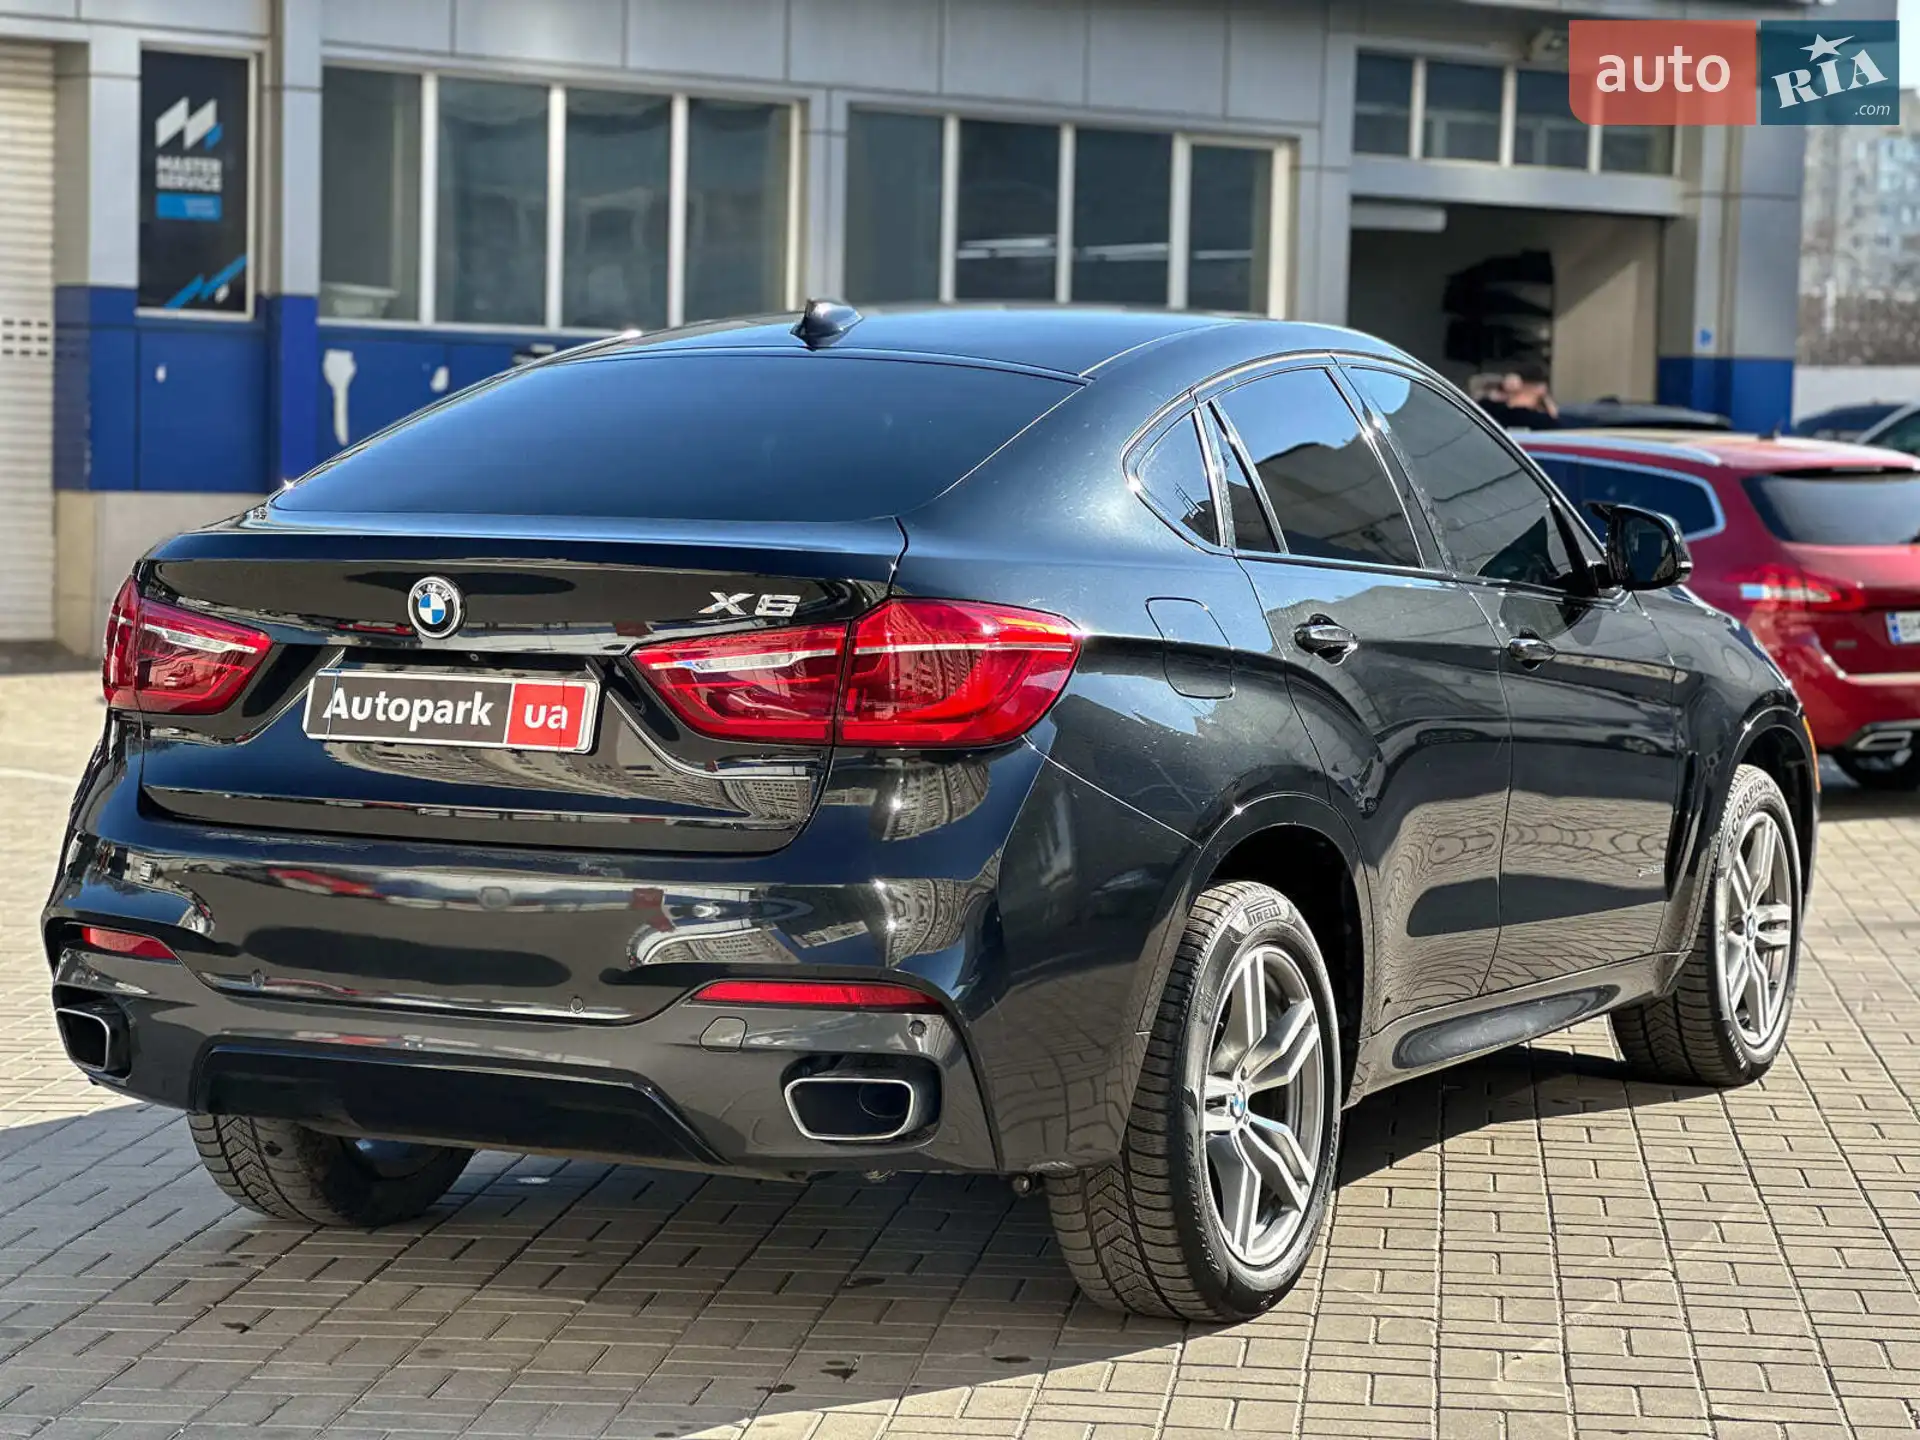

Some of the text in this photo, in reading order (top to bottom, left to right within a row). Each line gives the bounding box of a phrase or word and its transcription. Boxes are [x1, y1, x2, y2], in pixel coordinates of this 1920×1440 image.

[156, 155, 222, 174] MASTER
[156, 172, 222, 193] SERVICE
[414, 583, 452, 602] BMW
[698, 591, 801, 617] X6
[322, 686, 569, 732] Autopark ua
[1727, 778, 1770, 853] SCORPION
[1243, 898, 1282, 927] PIRELLI
